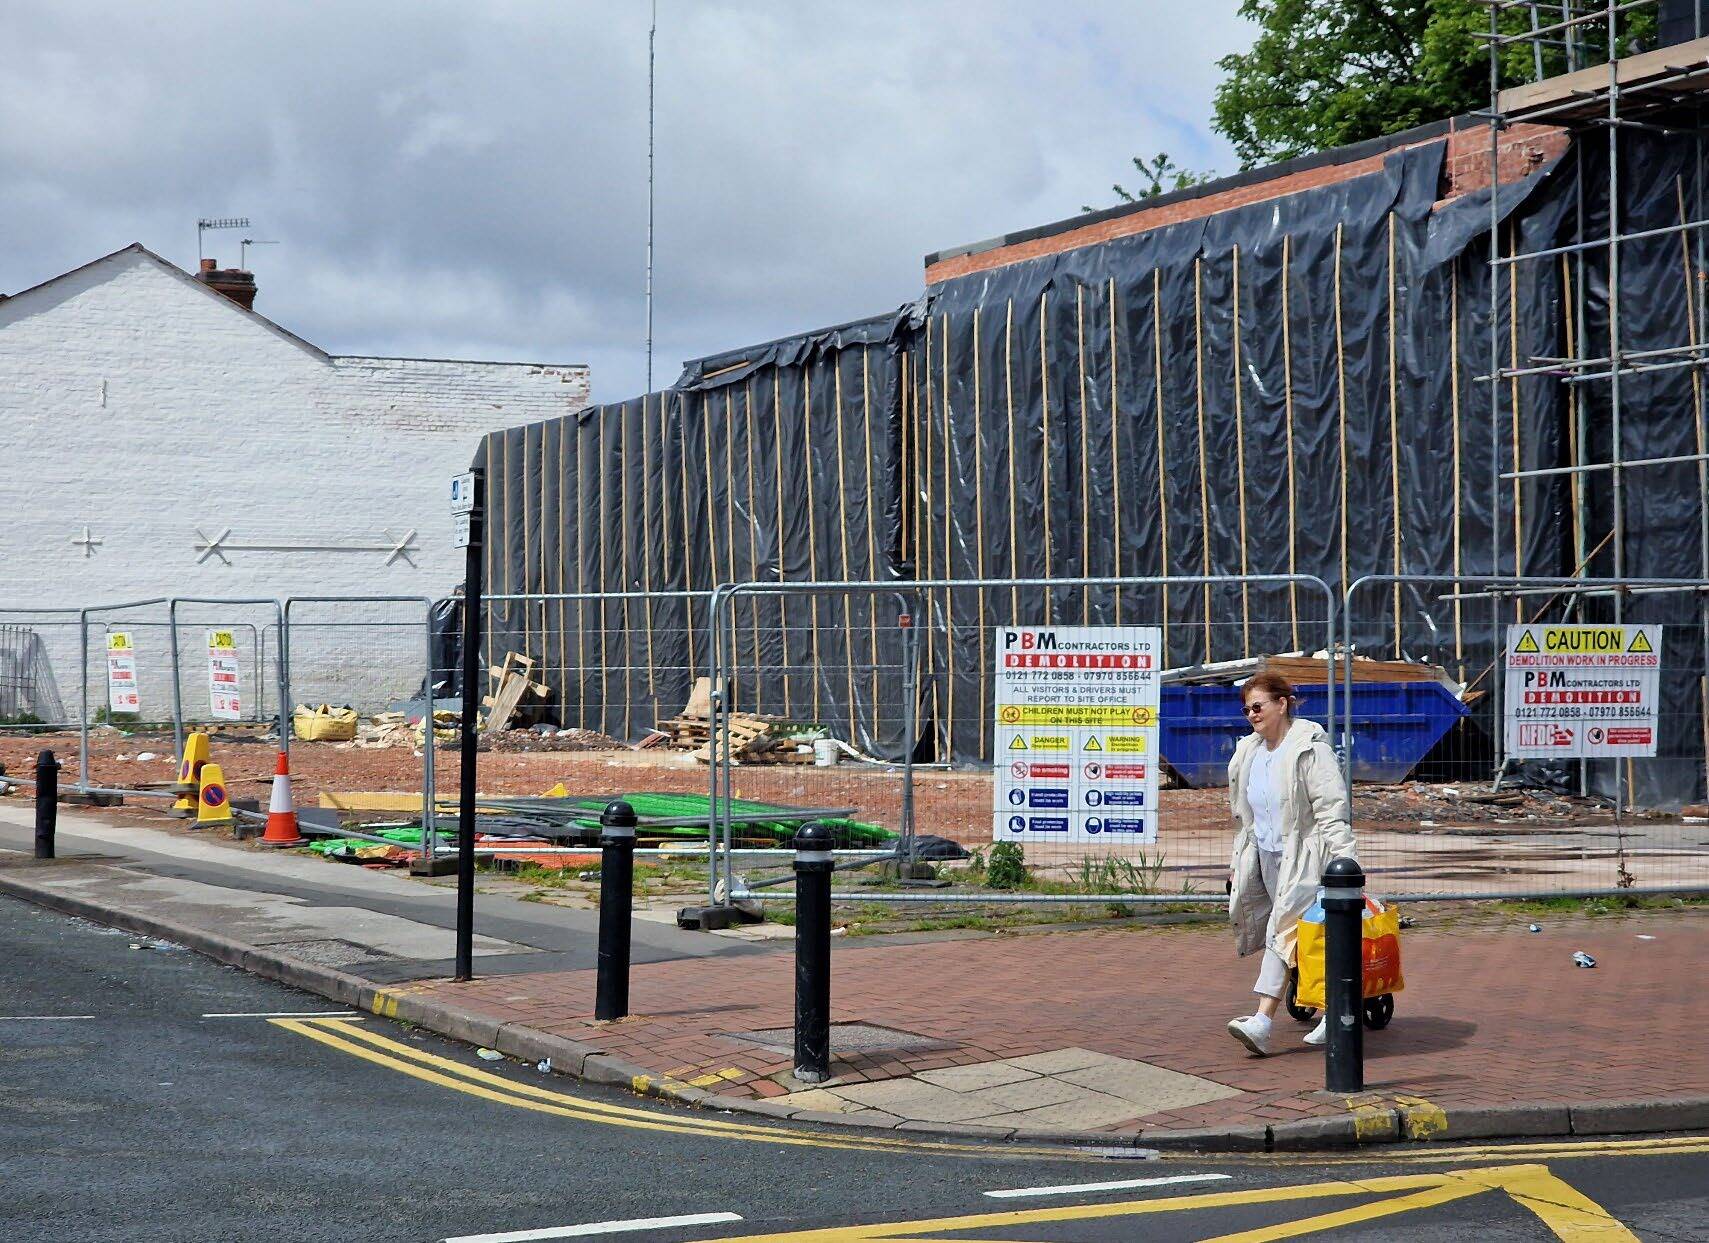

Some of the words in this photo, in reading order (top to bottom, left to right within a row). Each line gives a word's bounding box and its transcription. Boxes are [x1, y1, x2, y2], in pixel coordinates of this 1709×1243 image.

[1005, 631, 1057, 650] PBM
[1057, 642, 1130, 651] CONTRACTORS
[1133, 642, 1151, 651] LTD
[1546, 630, 1621, 650] CAUTION
[1010, 655, 1147, 668] DEMOLITION
[1509, 655, 1567, 666] DEMOLITION
[1568, 655, 1594, 666] WORK
[1597, 655, 1606, 666] IN
[1608, 655, 1658, 666] PROGRESS
[1005, 671, 1028, 681] 0121
[1031, 671, 1049, 681] 772
[1051, 671, 1075, 681] 0858
[1083, 671, 1113, 681] 07970
[1116, 671, 1151, 681] 856644
[1524, 671, 1566, 688] PBM
[1566, 679, 1624, 688] CONTRACTORS
[1626, 679, 1641, 688] LTD
[1013, 686, 1029, 694] ALL
[1031, 686, 1069, 694] VISITORS
[1080, 686, 1116, 694] DRIVERS
[1119, 686, 1142, 695] MUST
[1027, 695, 1061, 703] REPORT
[1064, 695, 1075, 703] TO
[1078, 695, 1095, 703] SITE
[1097, 696, 1128, 704] OFFICE
[1528, 691, 1637, 704] DEMOLITION
[1022, 707, 1063, 715] CHILDREN
[1090, 708, 1108, 716] NOT
[1110, 708, 1131, 716] PLAY
[1515, 707, 1537, 719] 0121
[1540, 707, 1556, 718] 772
[1588, 707, 1616, 718] 07970
[1619, 706, 1651, 718] 856644
[1050, 716, 1062, 724] ON
[1065, 716, 1082, 724] THIS
[1084, 716, 1103, 724] SITE
[1520, 724, 1556, 746] NFDC
